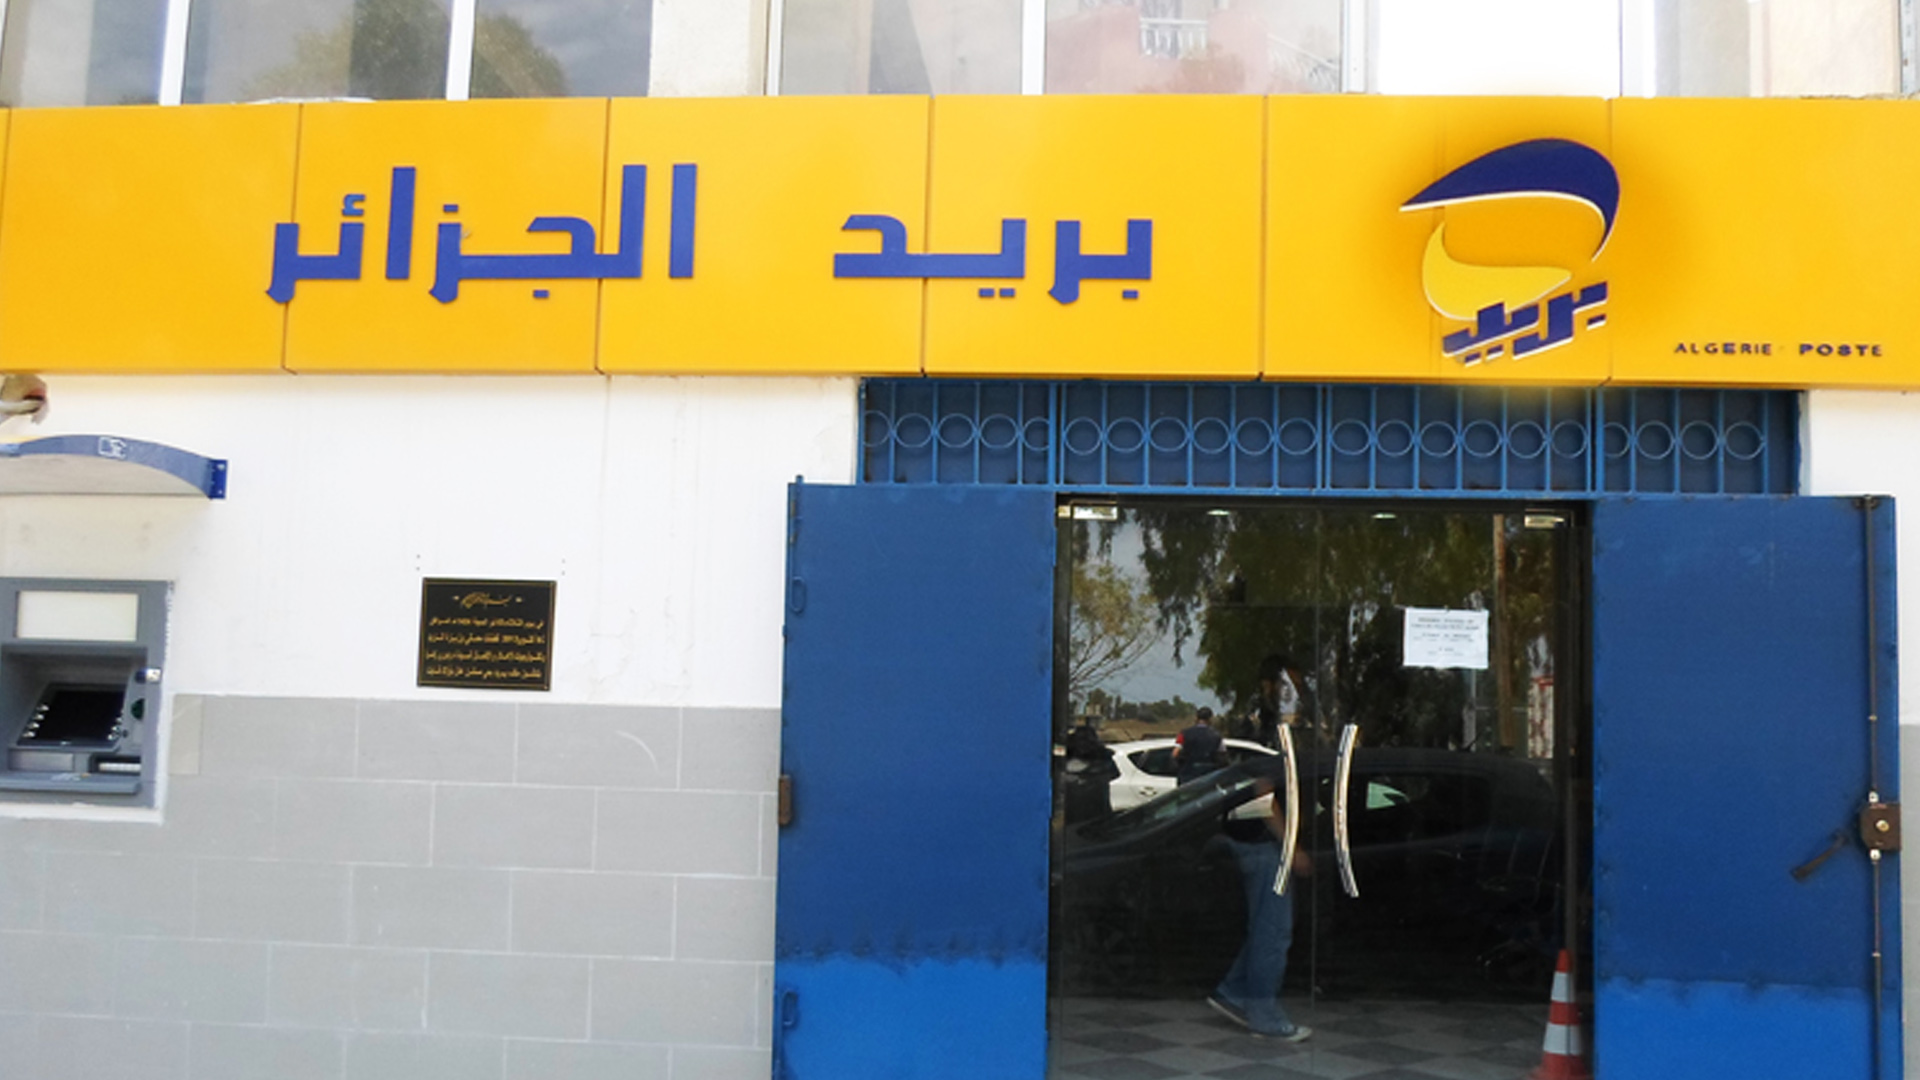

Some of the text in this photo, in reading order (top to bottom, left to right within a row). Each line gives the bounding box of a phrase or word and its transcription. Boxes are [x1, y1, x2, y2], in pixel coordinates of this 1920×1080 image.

[267, 163, 1153, 304] بريد الجزائر
[1674, 342, 1883, 358] ALGERIE POSTE
